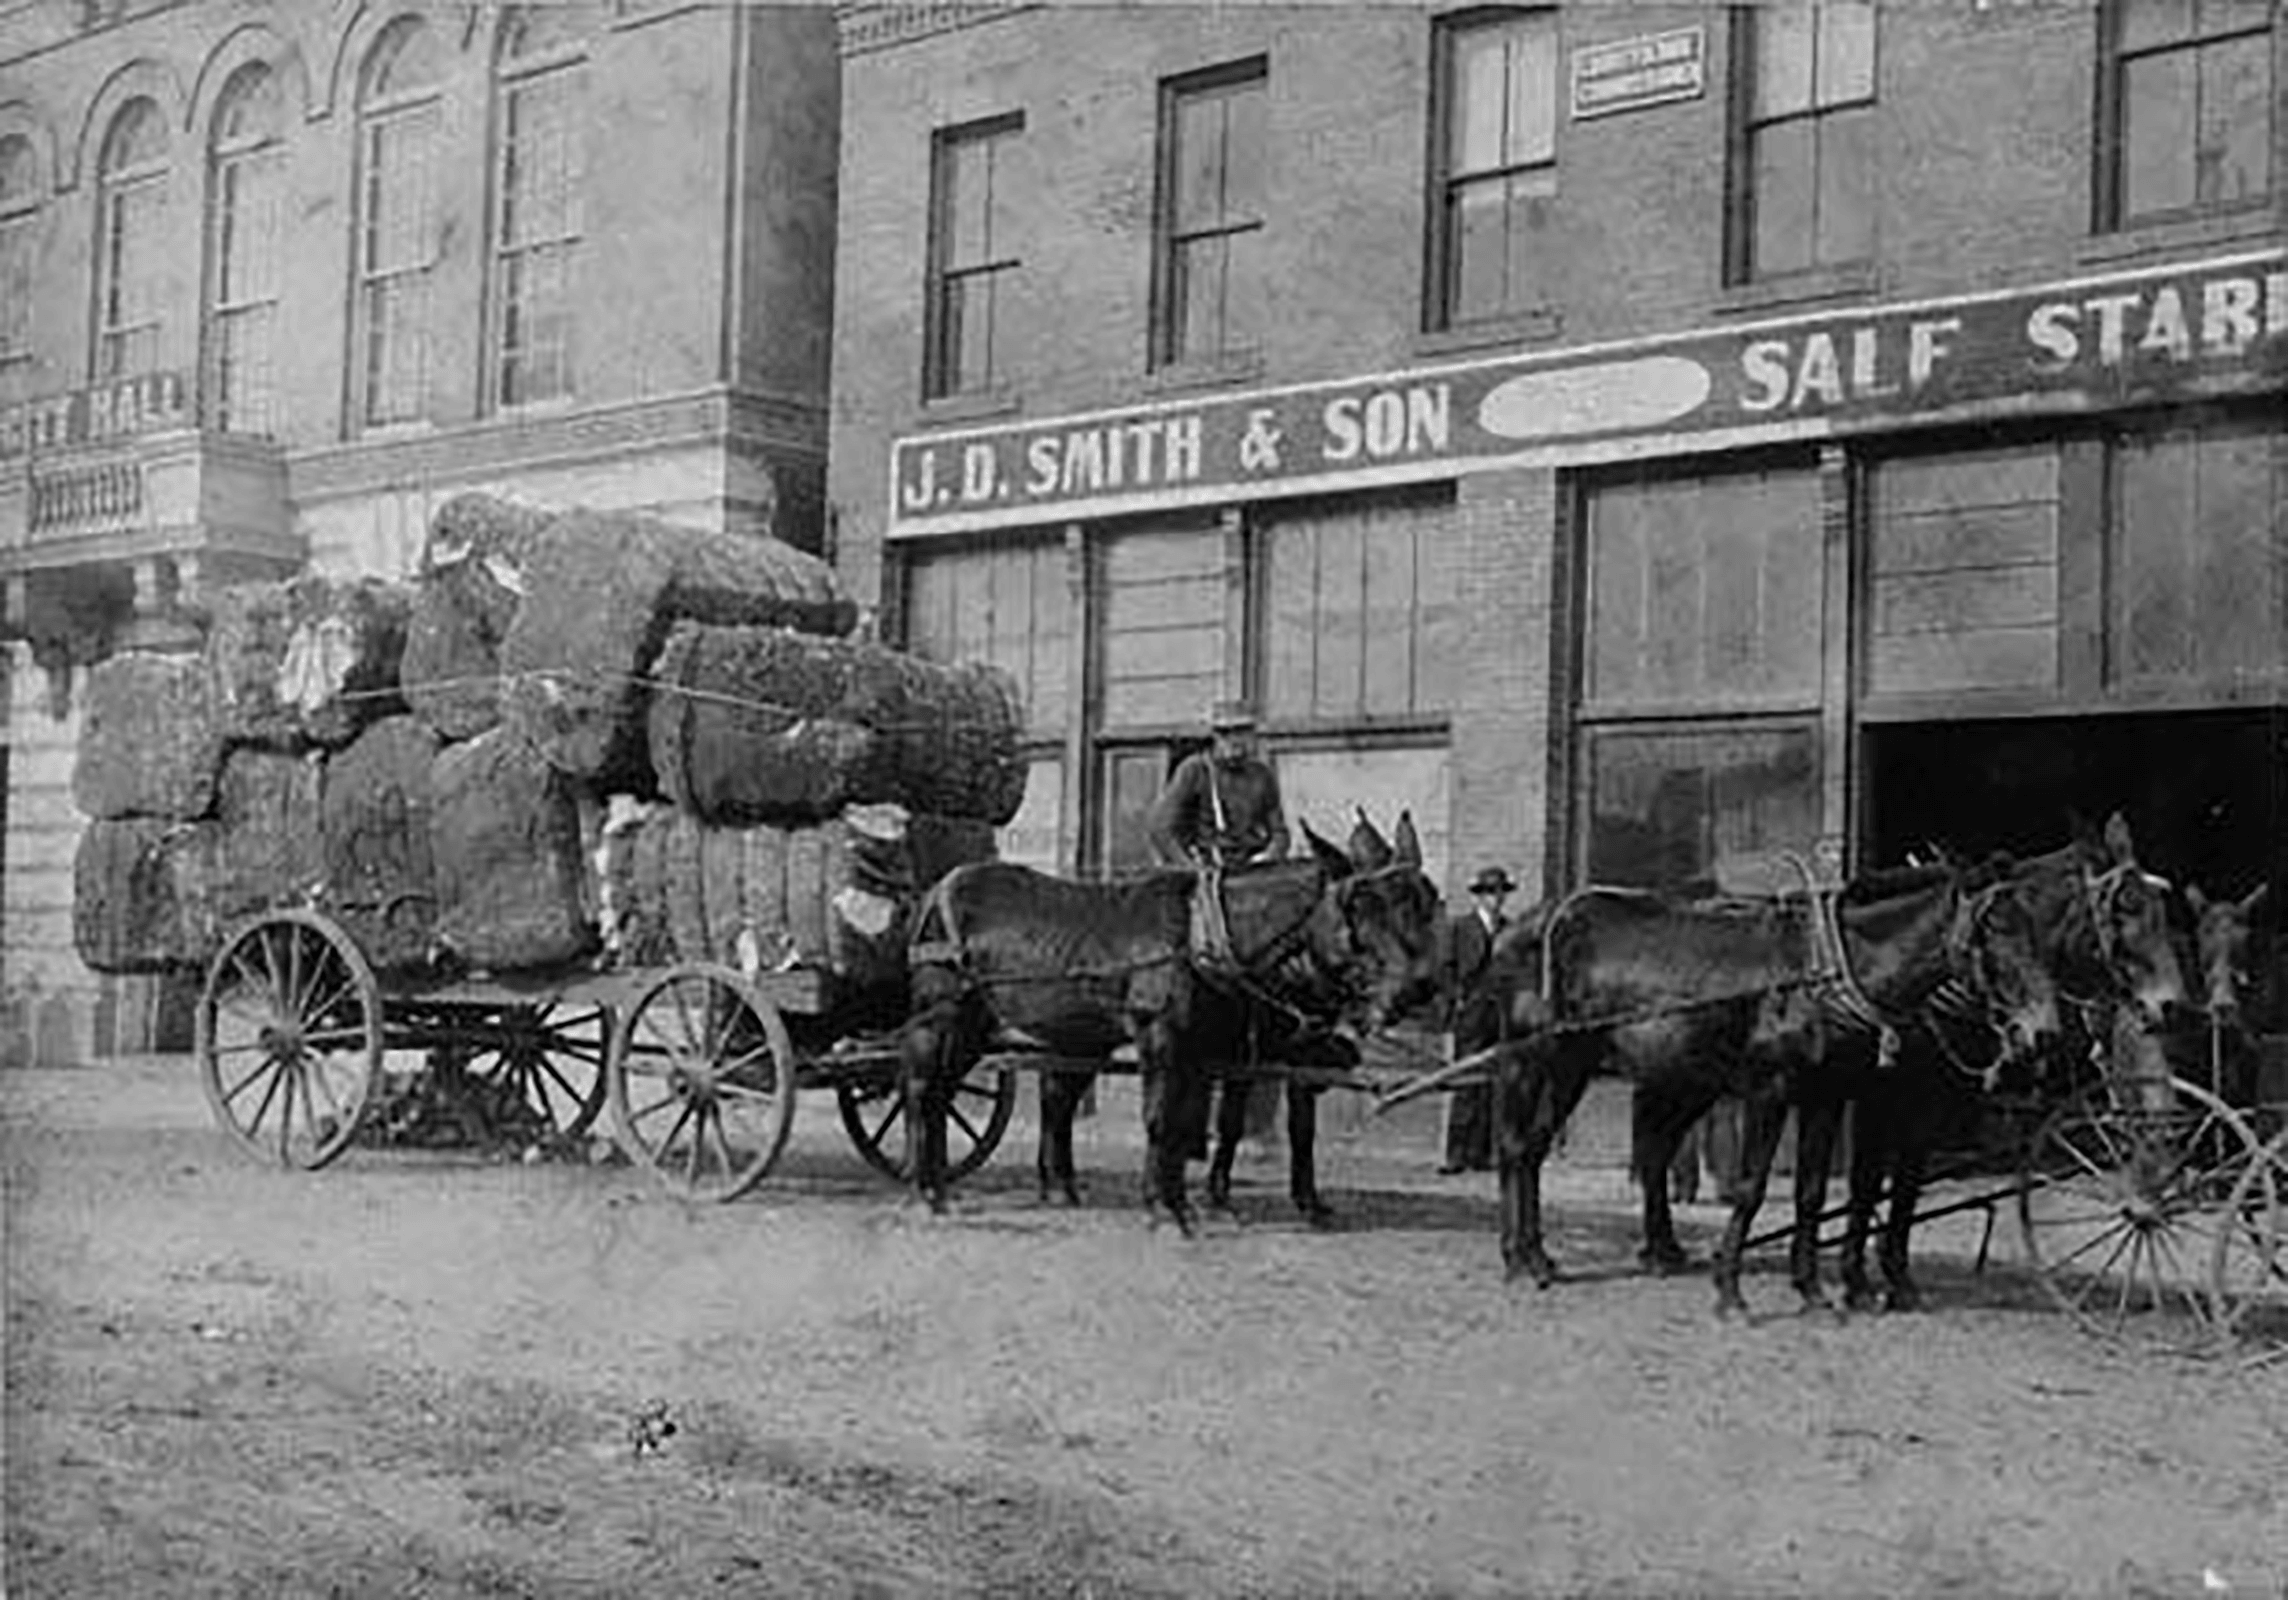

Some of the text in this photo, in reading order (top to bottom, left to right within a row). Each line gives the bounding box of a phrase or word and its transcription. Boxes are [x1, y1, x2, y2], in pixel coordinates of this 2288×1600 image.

[1026, 414, 1201, 494] SMITH
[1241, 408, 1282, 471] &
[1322, 383, 1449, 459] SON
